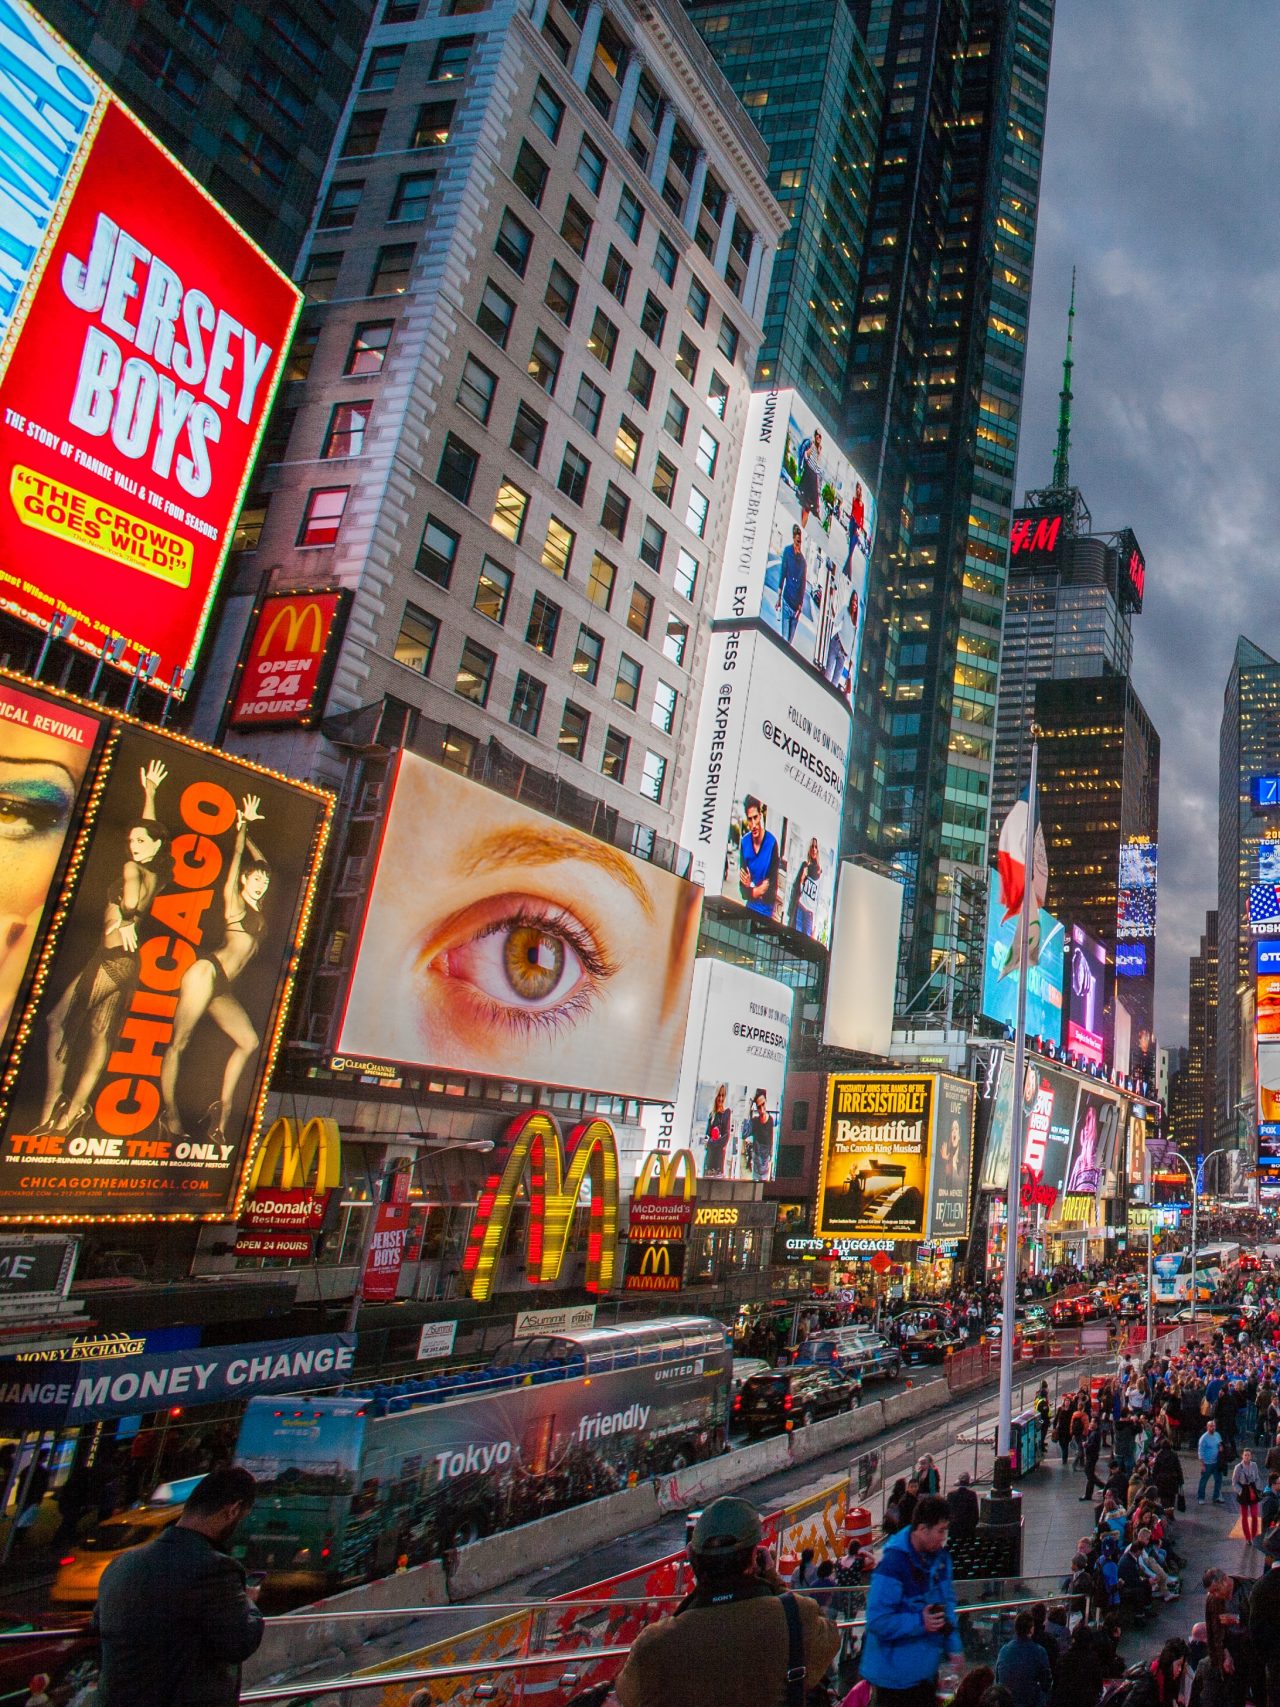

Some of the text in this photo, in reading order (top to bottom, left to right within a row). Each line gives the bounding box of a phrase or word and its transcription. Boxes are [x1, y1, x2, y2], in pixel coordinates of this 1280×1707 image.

[61, 212, 272, 425] JERSEY
[69, 325, 222, 498] BOYS
[758, 388, 778, 444] RUNWAY
[6, 407, 219, 541] THE STORY OF FRANKIE VALLI & THE FOUR SEASONS
[23, 495, 101, 540] GOES
[94, 506, 184, 557] CROWD
[257, 658, 313, 674] OPEN
[257, 674, 303, 698] 24
[240, 699, 309, 715] HOURS
[33, 713, 84, 743] REVIVAL
[787, 704, 813, 736] FOLLOW
[697, 682, 733, 845] @EXPRESSRUNWAY
[95, 781, 238, 1136] CHICAGO
[950, 1102, 962, 1115] LIVE
[836, 1119, 923, 1143] Beautiful
[1261, 1126, 1277, 1134] FOX
[10, 1134, 235, 1162] THE ONE THE ONLY
[836, 1143, 921, 1155] The Carole King Musical
[5, 1155, 20, 1163] THE
[20, 1155, 93, 1166] LONGEST-RUNNING
[93, 1157, 131, 1167] AMERICAN
[130, 1159, 160, 1167] MUSICAL
[160, 1160, 169, 1168] IN
[169, 1160, 205, 1169] BROADWAY
[19, 1176, 210, 1191] CHICAGOTHEMUSICAL.COM
[243, 1199, 323, 1217] McDonald's
[631, 1204, 691, 1214] McDonald's
[694, 1208, 739, 1225] XPRESS
[1061, 1195, 1092, 1222] FOREVER
[252, 1215, 307, 1225] Restaurant
[236, 1239, 309, 1251] OPEN 24 HOURS
[370, 1229, 409, 1249] JERSEY
[786, 1239, 895, 1251] GIFTS LUGGAGE
[373, 1249, 402, 1267] BOYS
[529, 1313, 567, 1325] Summit
[16, 1340, 146, 1362] MONEY EXCHANGE
[72, 1345, 356, 1409] MONEY CHANGE
[655, 1365, 693, 1381] UNITED
[578, 1403, 651, 1442] friendly
[435, 1440, 512, 1482] Tokyo
